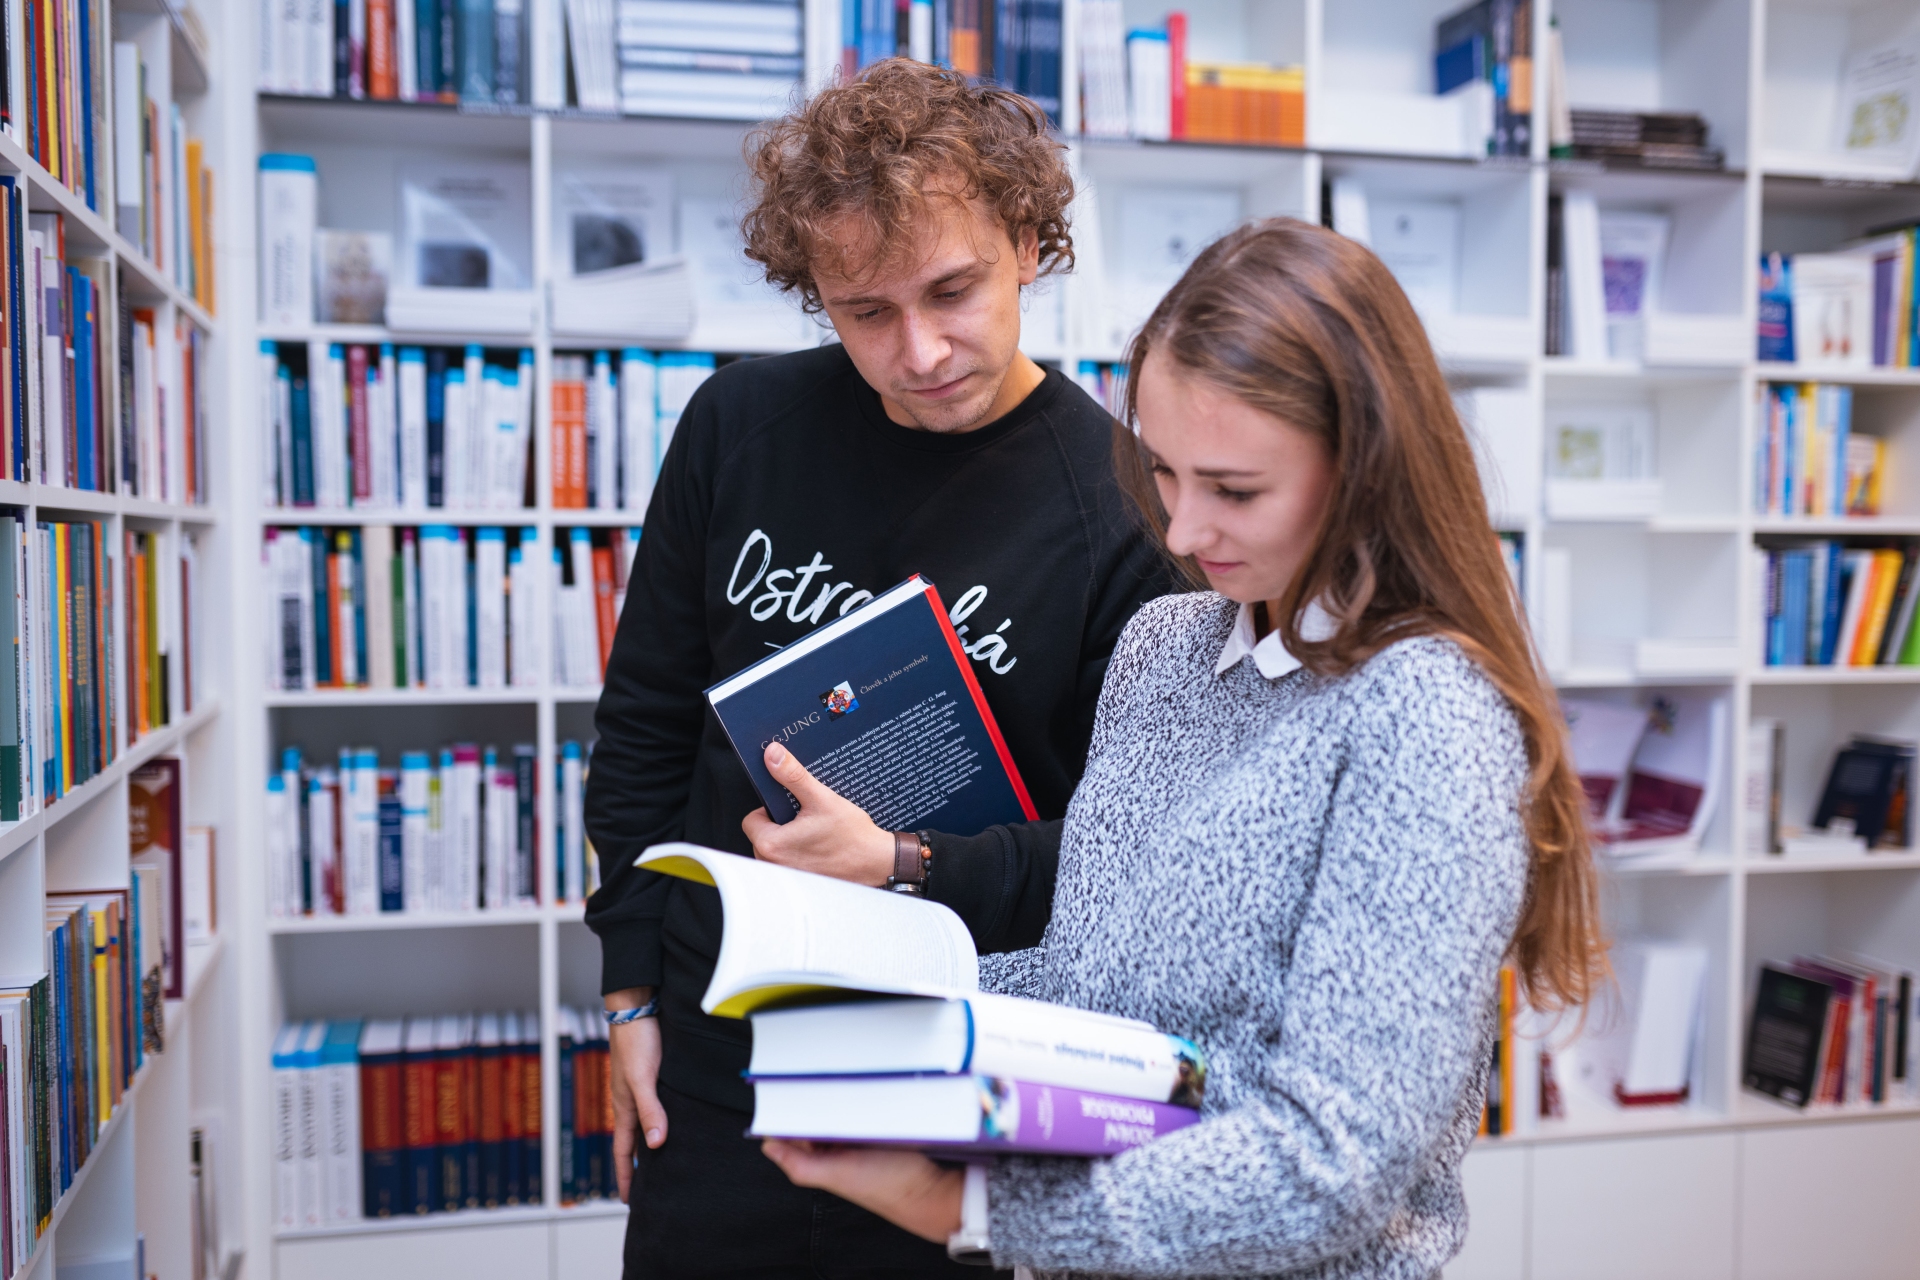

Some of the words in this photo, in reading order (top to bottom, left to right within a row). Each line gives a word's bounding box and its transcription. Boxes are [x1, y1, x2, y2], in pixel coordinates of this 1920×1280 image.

[859, 678, 883, 695] Člověk
[887, 669, 903, 682] jeho
[902, 654, 928, 673] symboly
